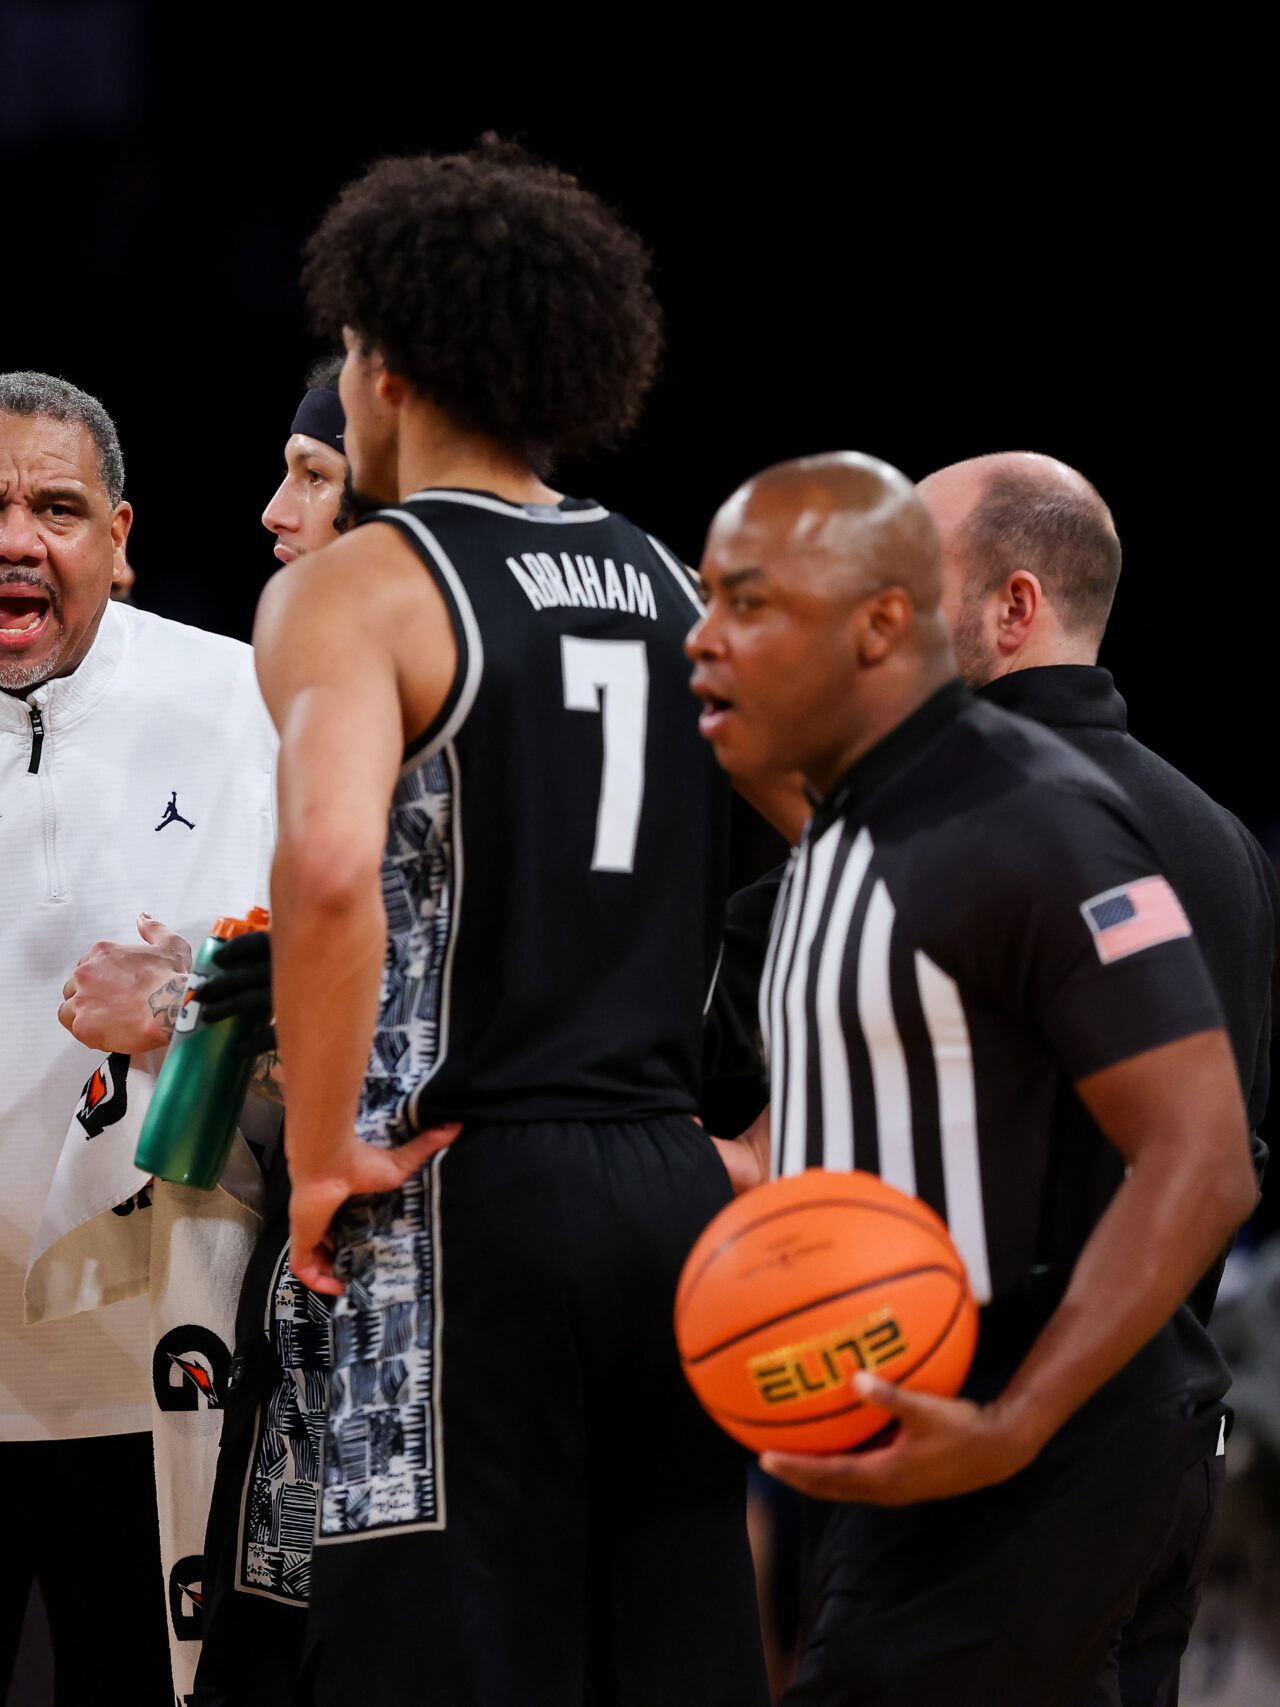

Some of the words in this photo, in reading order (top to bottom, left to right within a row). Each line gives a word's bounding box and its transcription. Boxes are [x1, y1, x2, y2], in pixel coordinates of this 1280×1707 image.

[505, 551, 658, 621] ABRAHAM
[560, 634, 650, 873] 7
[754, 1318, 907, 1404] ELITE
